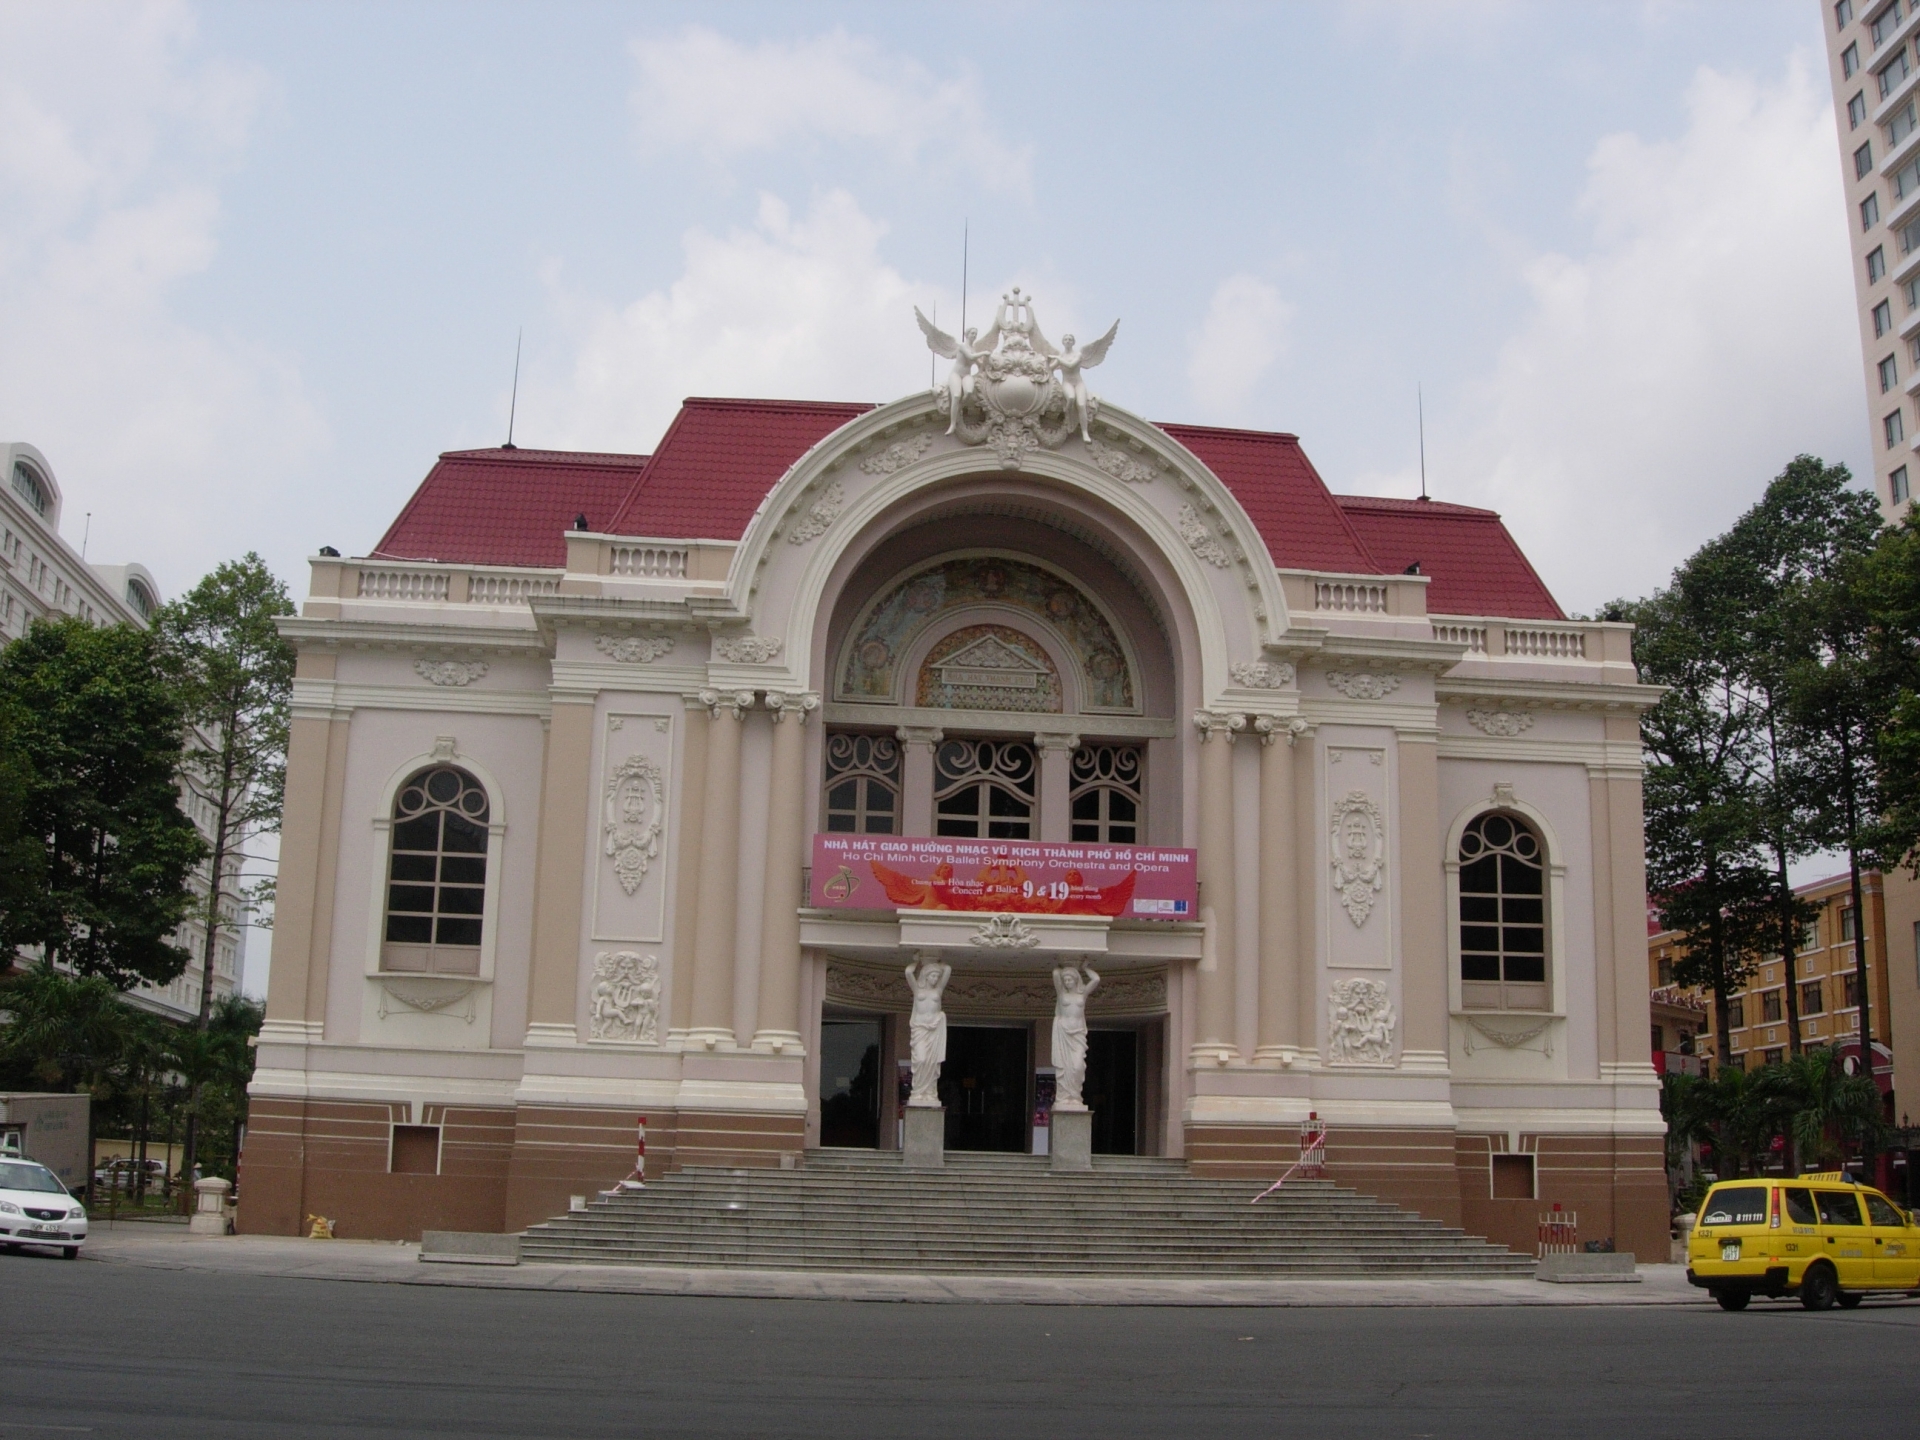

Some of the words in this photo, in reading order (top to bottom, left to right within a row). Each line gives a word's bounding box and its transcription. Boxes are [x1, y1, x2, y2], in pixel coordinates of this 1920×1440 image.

[824, 838, 848, 850] NHÀ
[853, 839, 876, 851] HÁT
[880, 842, 908, 852] GIAO
[912, 841, 953, 854] HƯỞNG
[956, 845, 988, 856] NHẠC
[992, 844, 1008, 855] VŨ
[1012, 848, 1040, 859] KỊCH
[1043, 847, 1083, 859] THÀNH
[1087, 847, 1113, 860] PHỐ
[1115, 849, 1132, 861] HỒ
[1135, 850, 1156, 862] CHÍ
[1159, 853, 1189, 863] MINH
[843, 851, 860, 861] Ho
[863, 852, 884, 862] Chi
[887, 853, 916, 863] Minh
[919, 854, 942, 865] City
[946, 854, 980, 865] Ballet
[983, 856, 1045, 869] Symphony
[1048, 860, 1105, 871] Orchestra
[1108, 861, 1131, 871] and
[1134, 863, 1170, 874] Opera
[952, 886, 983, 896] Concert
[996, 885, 1019, 894] Ballet
[1022, 879, 1033, 899] 9
[1037, 885, 1047, 897] &
[1048, 881, 1070, 900] 19
[1698, 1230, 1713, 1238] 1331
[1785, 1243, 1799, 1252] 1331
